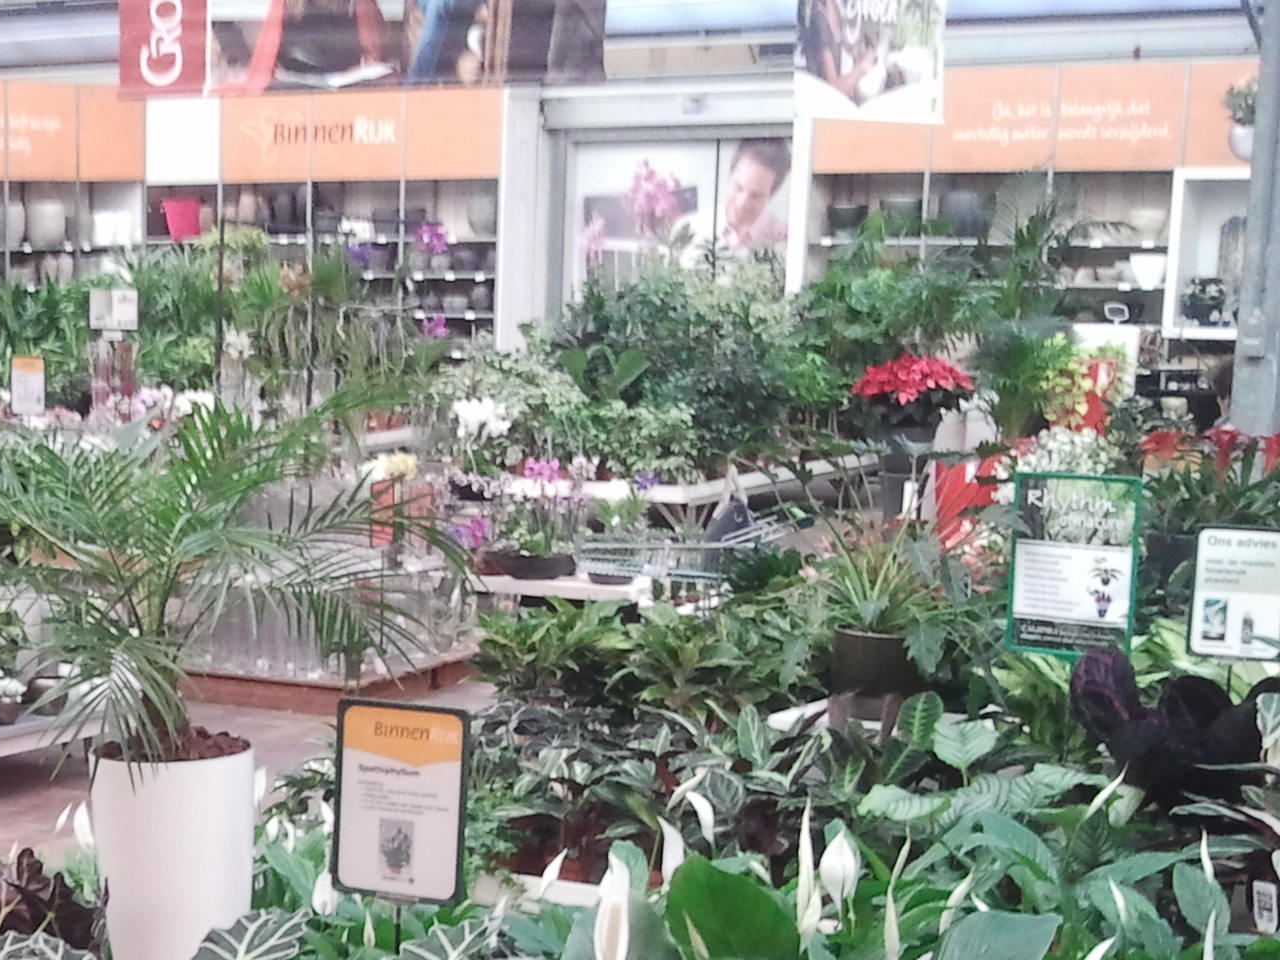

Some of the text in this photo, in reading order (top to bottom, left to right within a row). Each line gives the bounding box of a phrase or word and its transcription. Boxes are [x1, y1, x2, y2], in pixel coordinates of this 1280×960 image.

[1027, 487, 1117, 516] Rhythm
[1207, 535, 1278, 550] Ons advies
